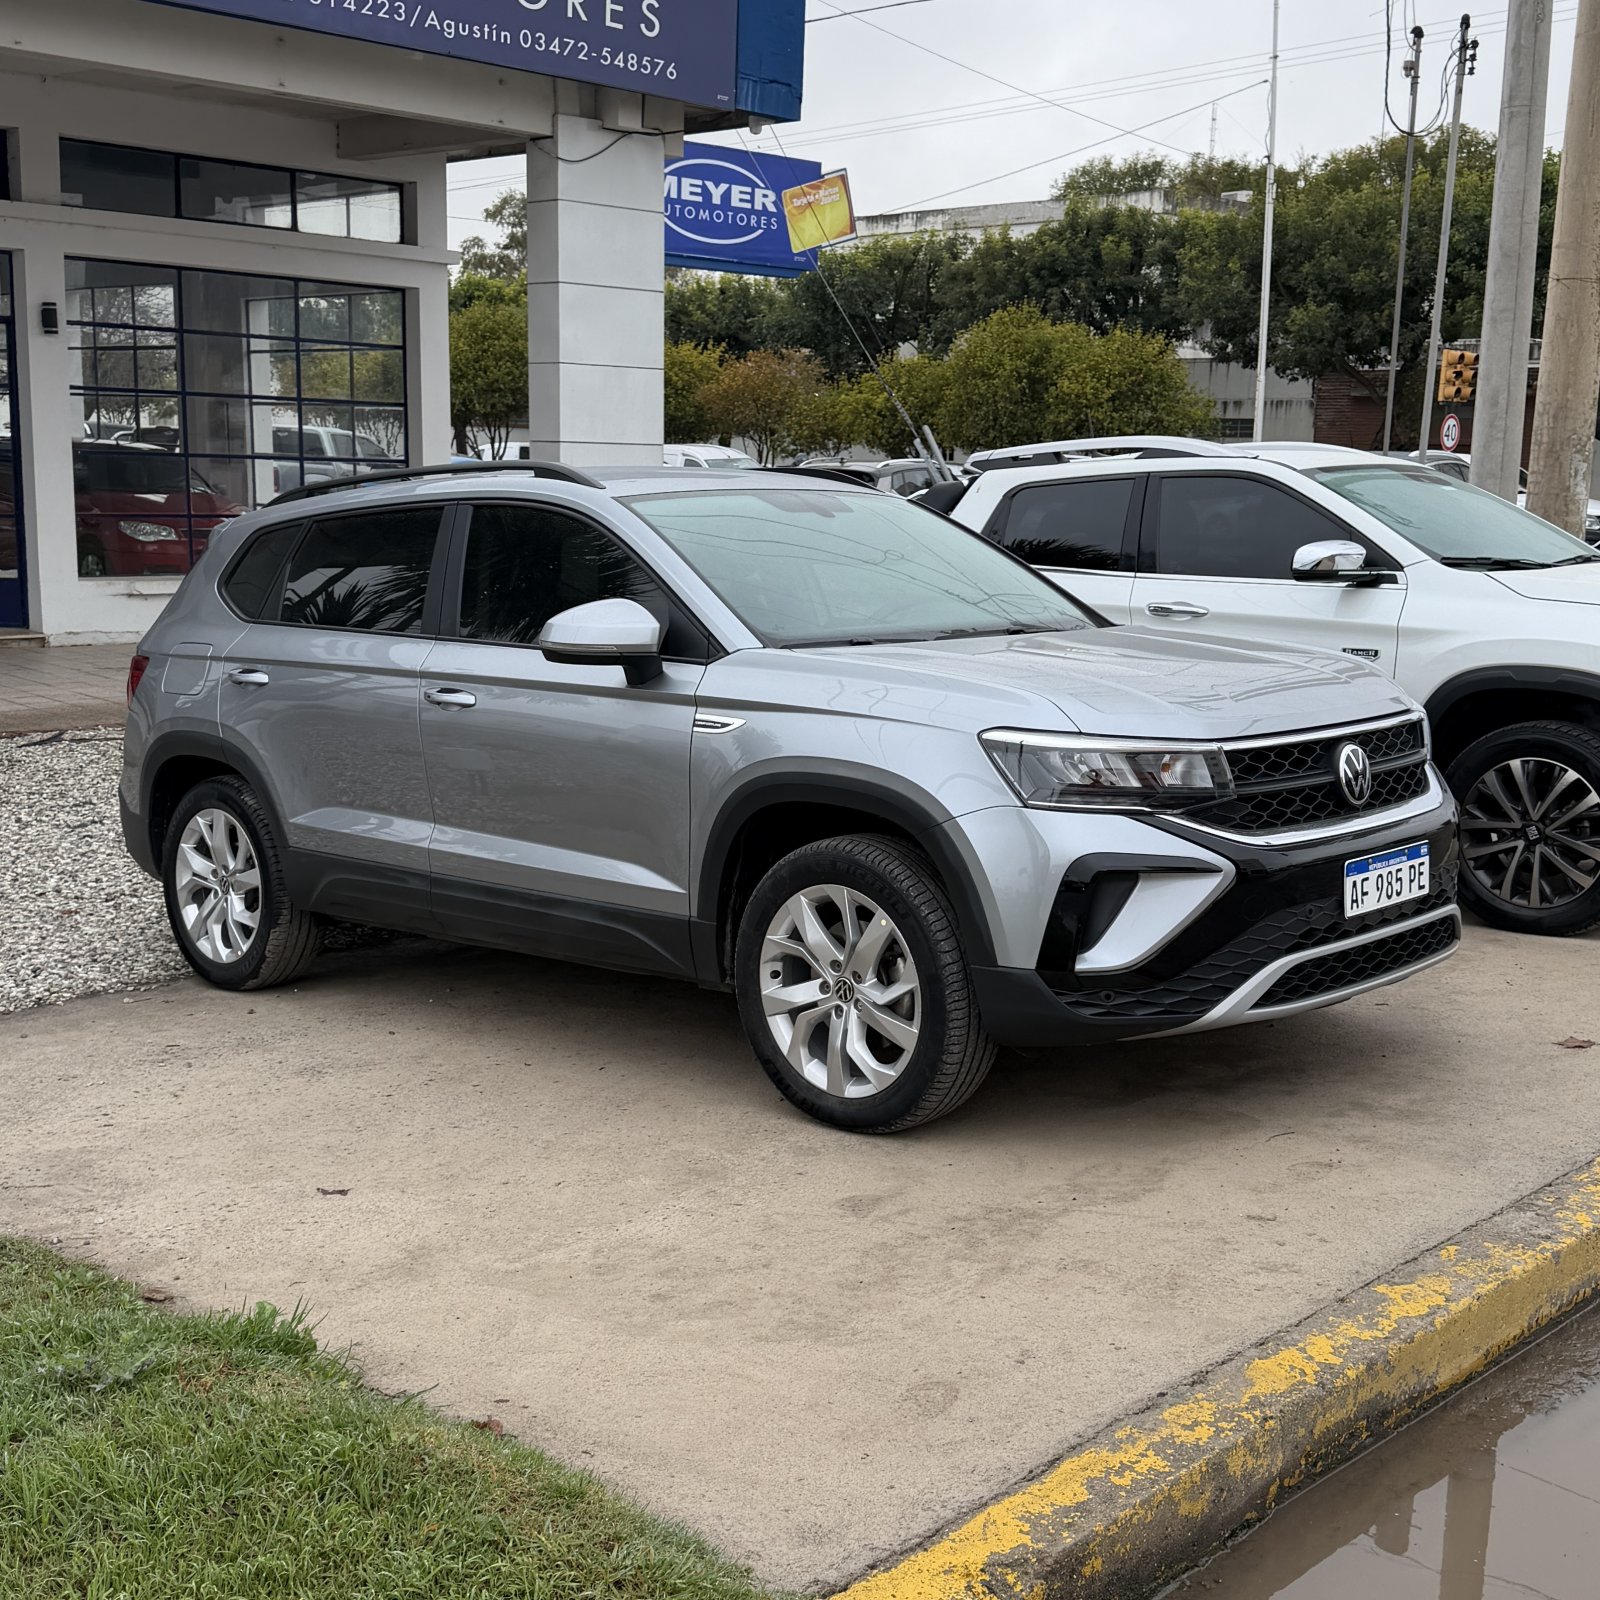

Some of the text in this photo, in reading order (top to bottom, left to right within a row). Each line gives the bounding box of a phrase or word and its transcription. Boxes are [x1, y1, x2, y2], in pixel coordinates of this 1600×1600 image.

[519, 29, 678, 80] 03472-548576
[664, 203, 778, 230] UTOMOTORES
[1444, 424, 1457, 441] 40
[1350, 861, 1426, 911] AF 985 PE
